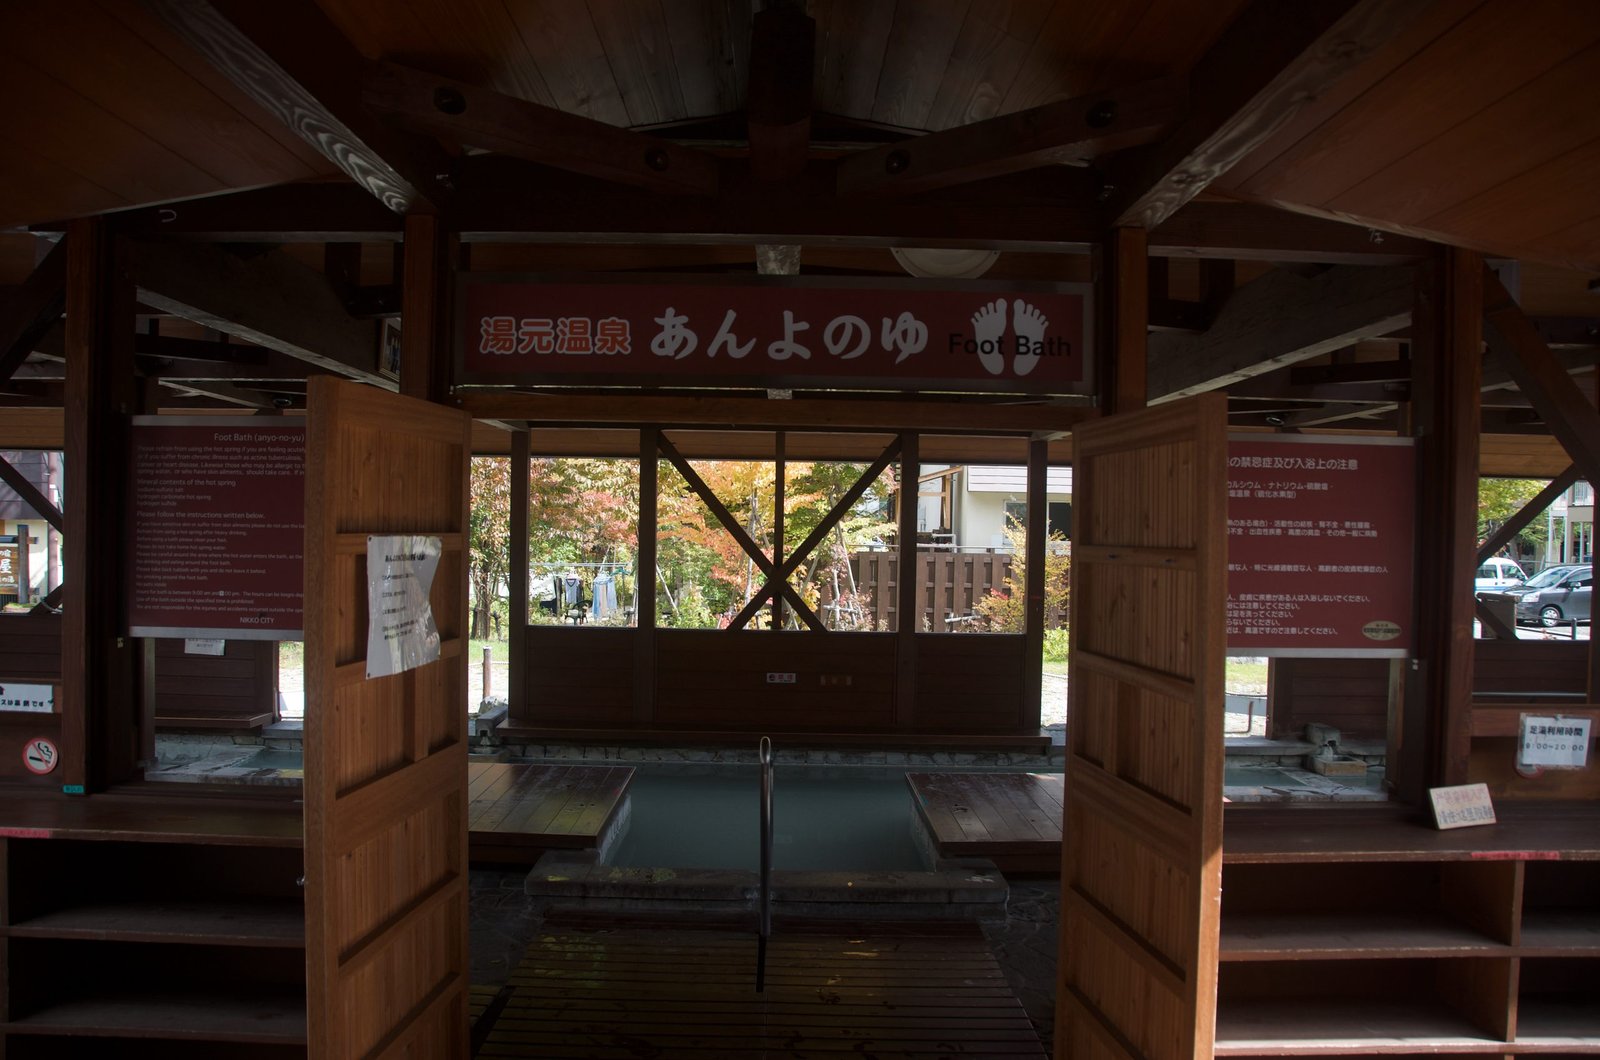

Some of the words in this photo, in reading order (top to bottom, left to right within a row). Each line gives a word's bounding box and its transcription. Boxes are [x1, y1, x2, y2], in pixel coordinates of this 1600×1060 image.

[479, 316, 632, 355] 湯元温泉
[650, 306, 929, 364] あんよのゆ
[948, 333, 1007, 356] Foot
[1014, 335, 1072, 358] Bath
[214, 433, 232, 441] Foot
[234, 433, 253, 441] Bath
[254, 433, 305, 443] (anyo-no-yu)
